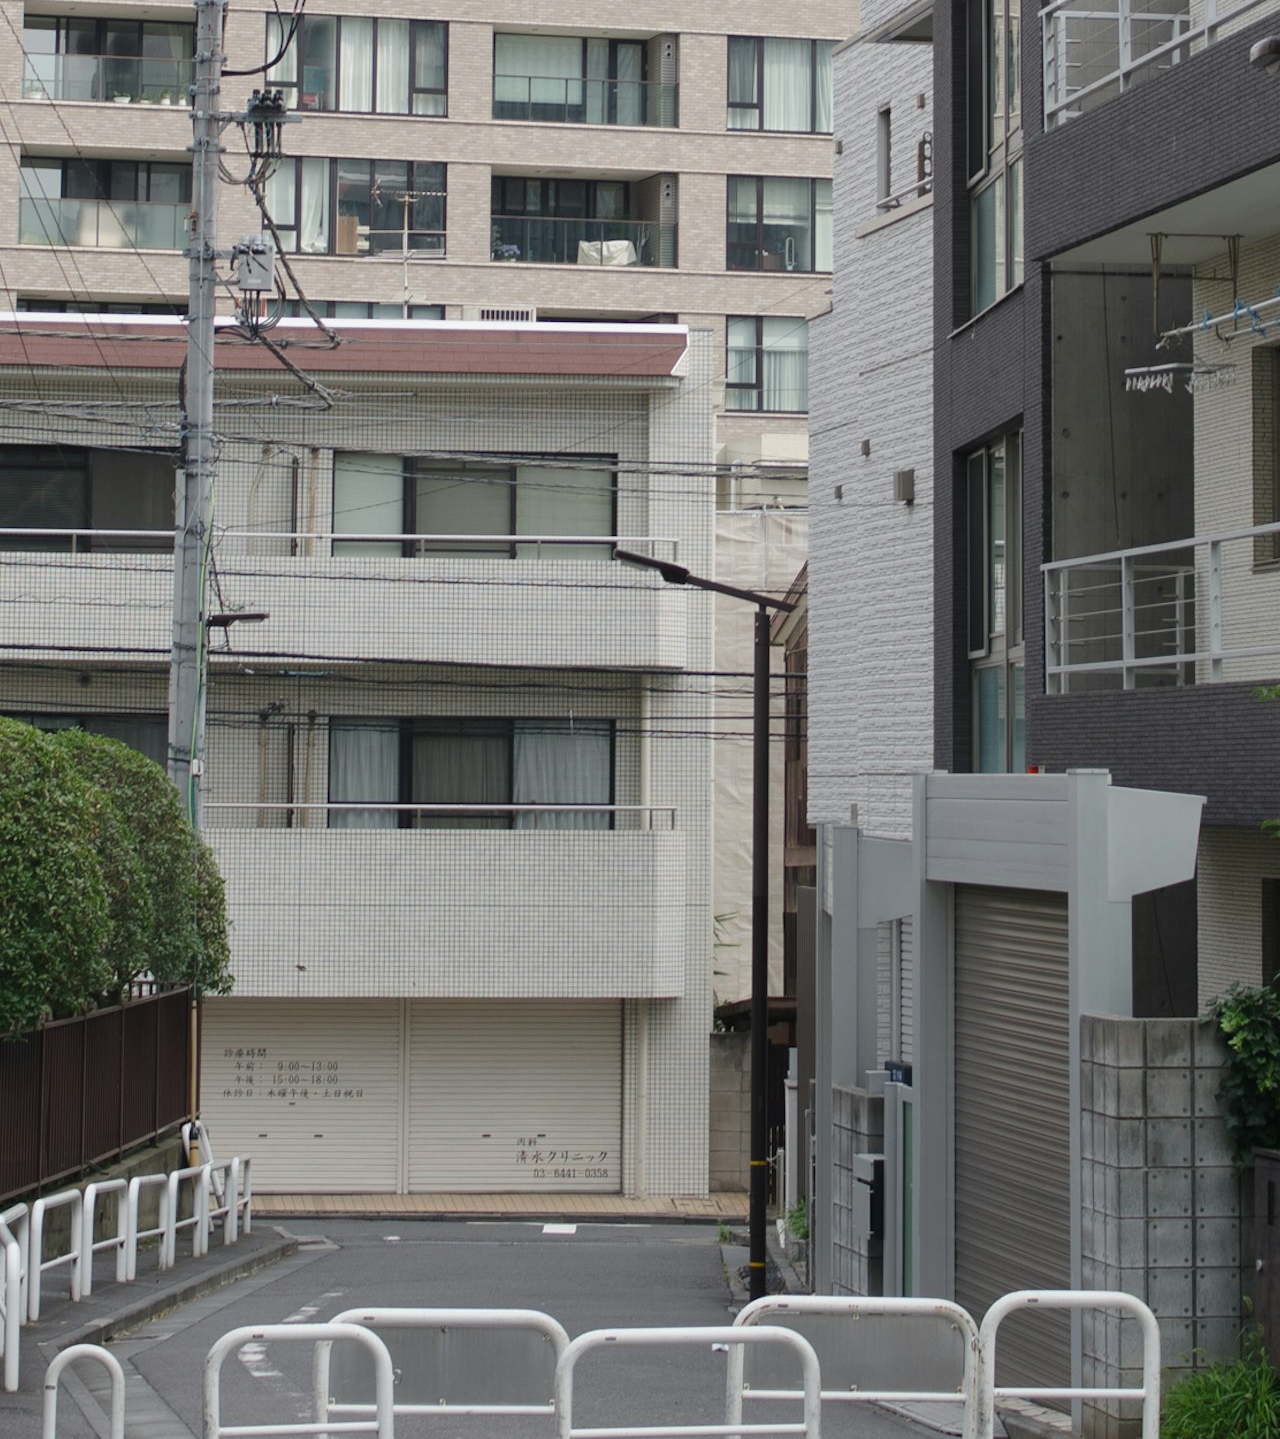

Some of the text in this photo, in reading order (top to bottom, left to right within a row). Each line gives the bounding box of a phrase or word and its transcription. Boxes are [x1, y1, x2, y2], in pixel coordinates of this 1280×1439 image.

[223, 1047, 268, 1058] 診療時間
[515, 1149, 608, 1164] 清水クリニック
